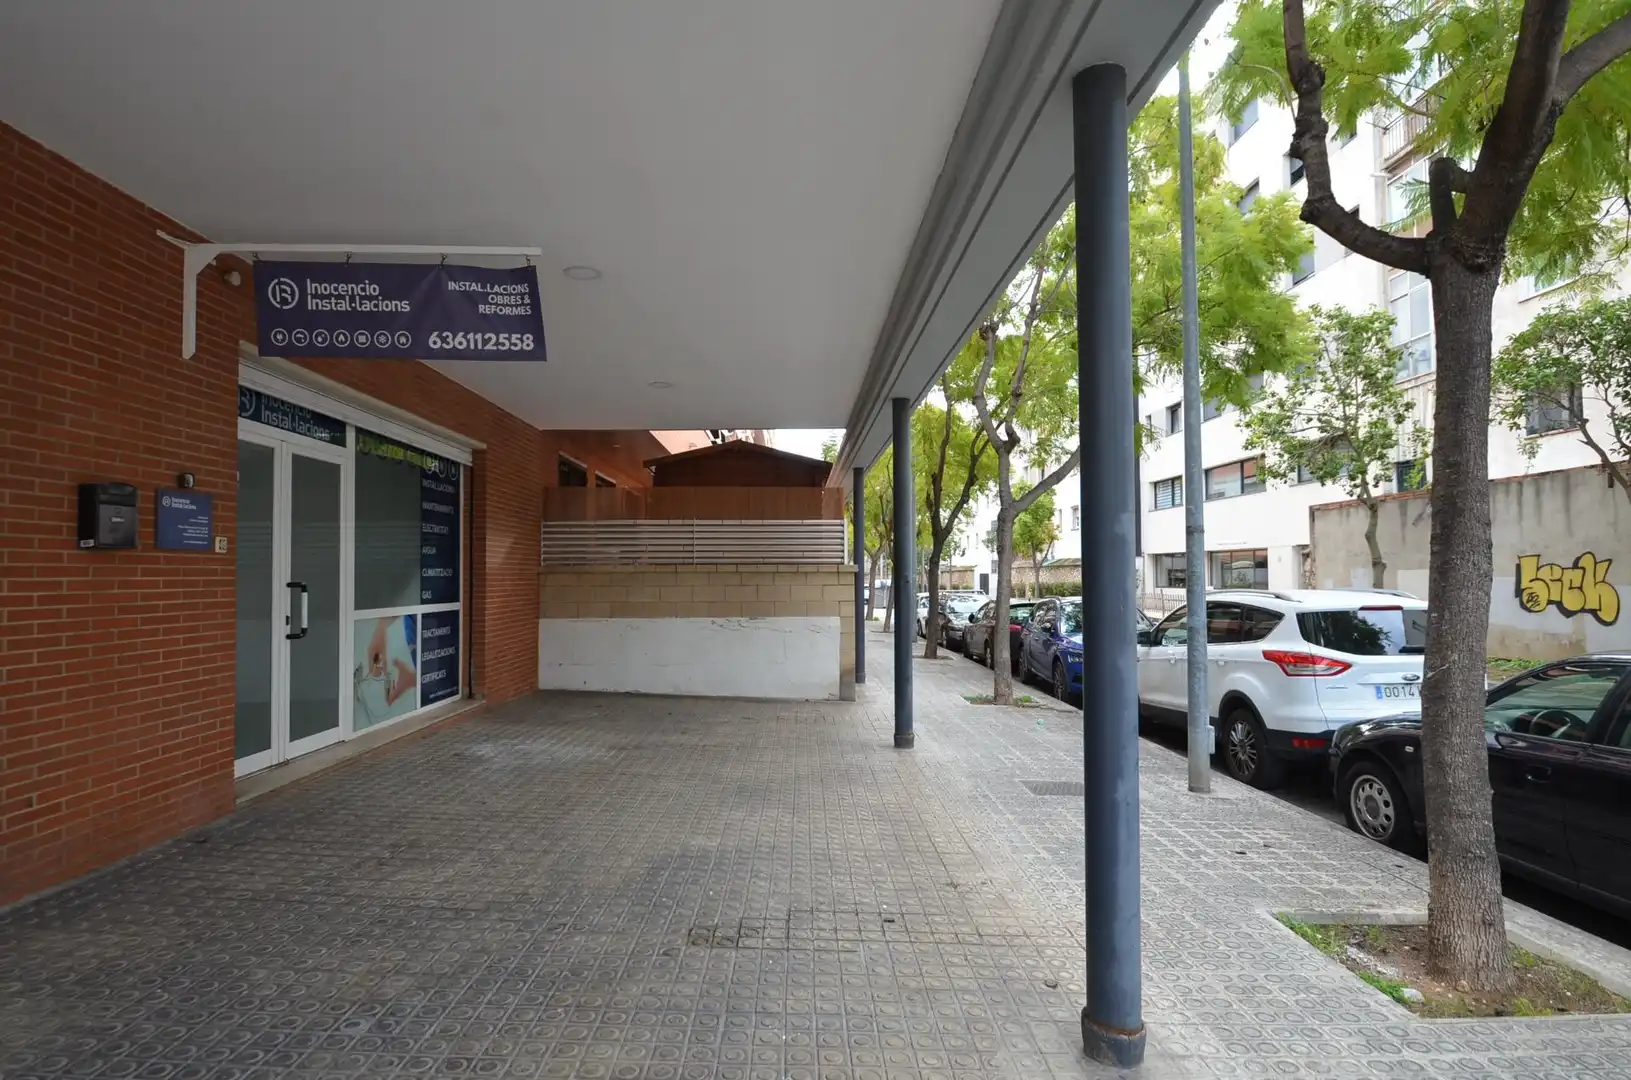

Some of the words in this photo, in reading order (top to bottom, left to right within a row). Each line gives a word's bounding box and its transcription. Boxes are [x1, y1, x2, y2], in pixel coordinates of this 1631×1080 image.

[307, 278, 379, 296] Inocencio
[448, 281, 529, 294] INSTAL.LACIONS
[488, 294, 521, 305] OBRES
[523, 294, 531, 304] &
[478, 304, 532, 315] REFORMES
[428, 331, 534, 351] 636112558
[422, 590, 433, 600] GAS
[1384, 685, 1415, 698] 0014
